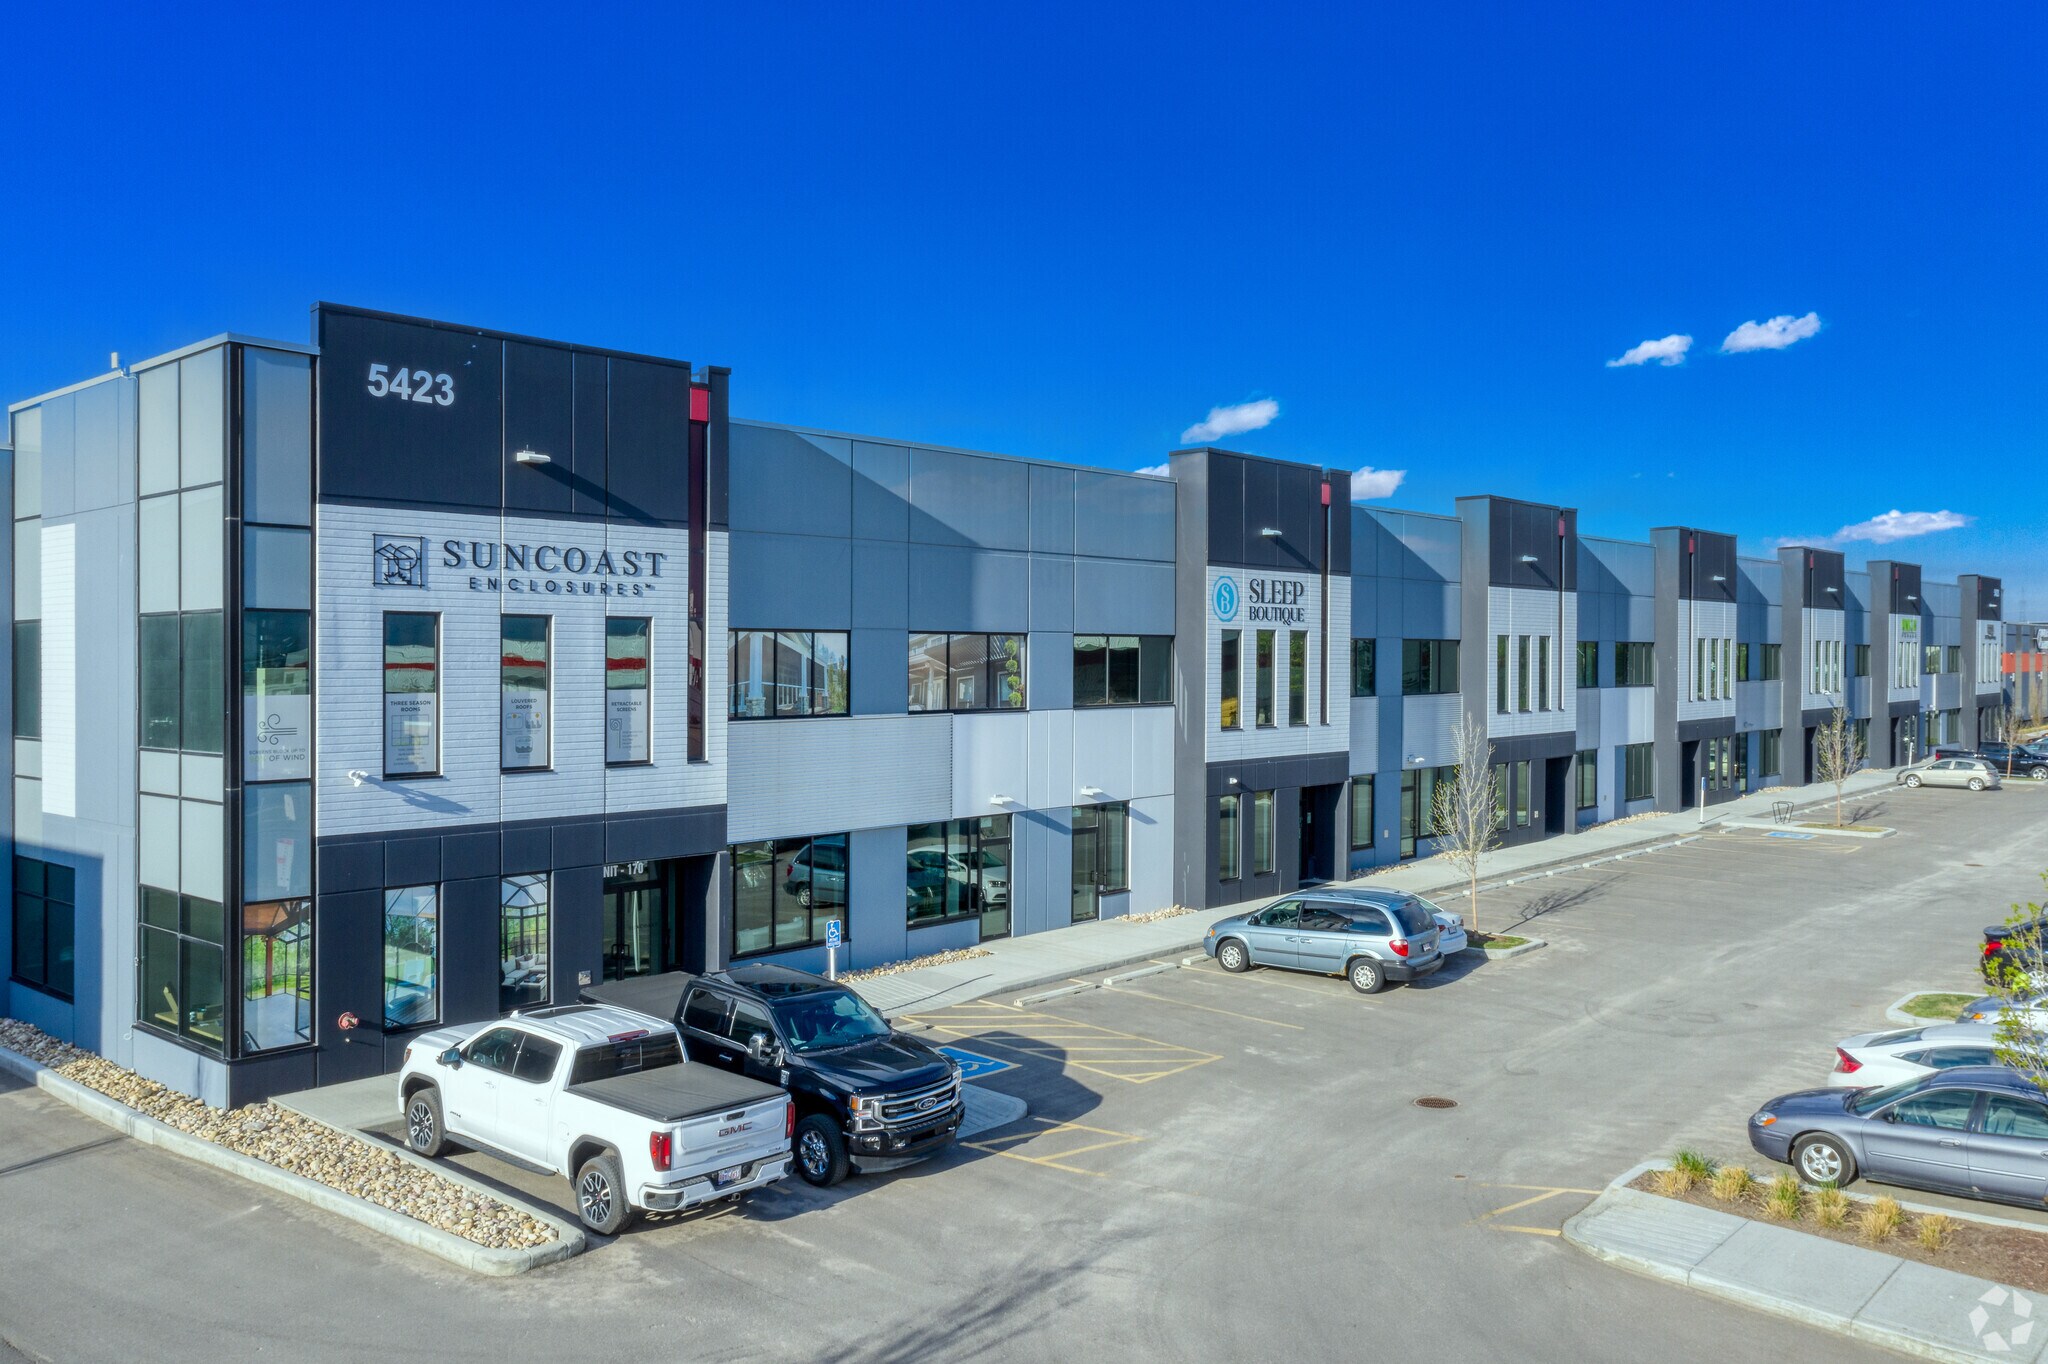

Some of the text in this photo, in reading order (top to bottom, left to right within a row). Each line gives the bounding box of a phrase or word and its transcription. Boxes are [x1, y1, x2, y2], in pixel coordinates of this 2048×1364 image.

[367, 363, 455, 406] 5423
[442, 540, 665, 577] SUNCOAST
[469, 576, 640, 596] ENCLOSURES
[1249, 578, 1304, 605] SLEEP
[1249, 606, 1305, 626] BOUTIQUE
[603, 865, 619, 878] NIT
[627, 862, 644, 875] 170
[718, 1121, 753, 1137] GMC
